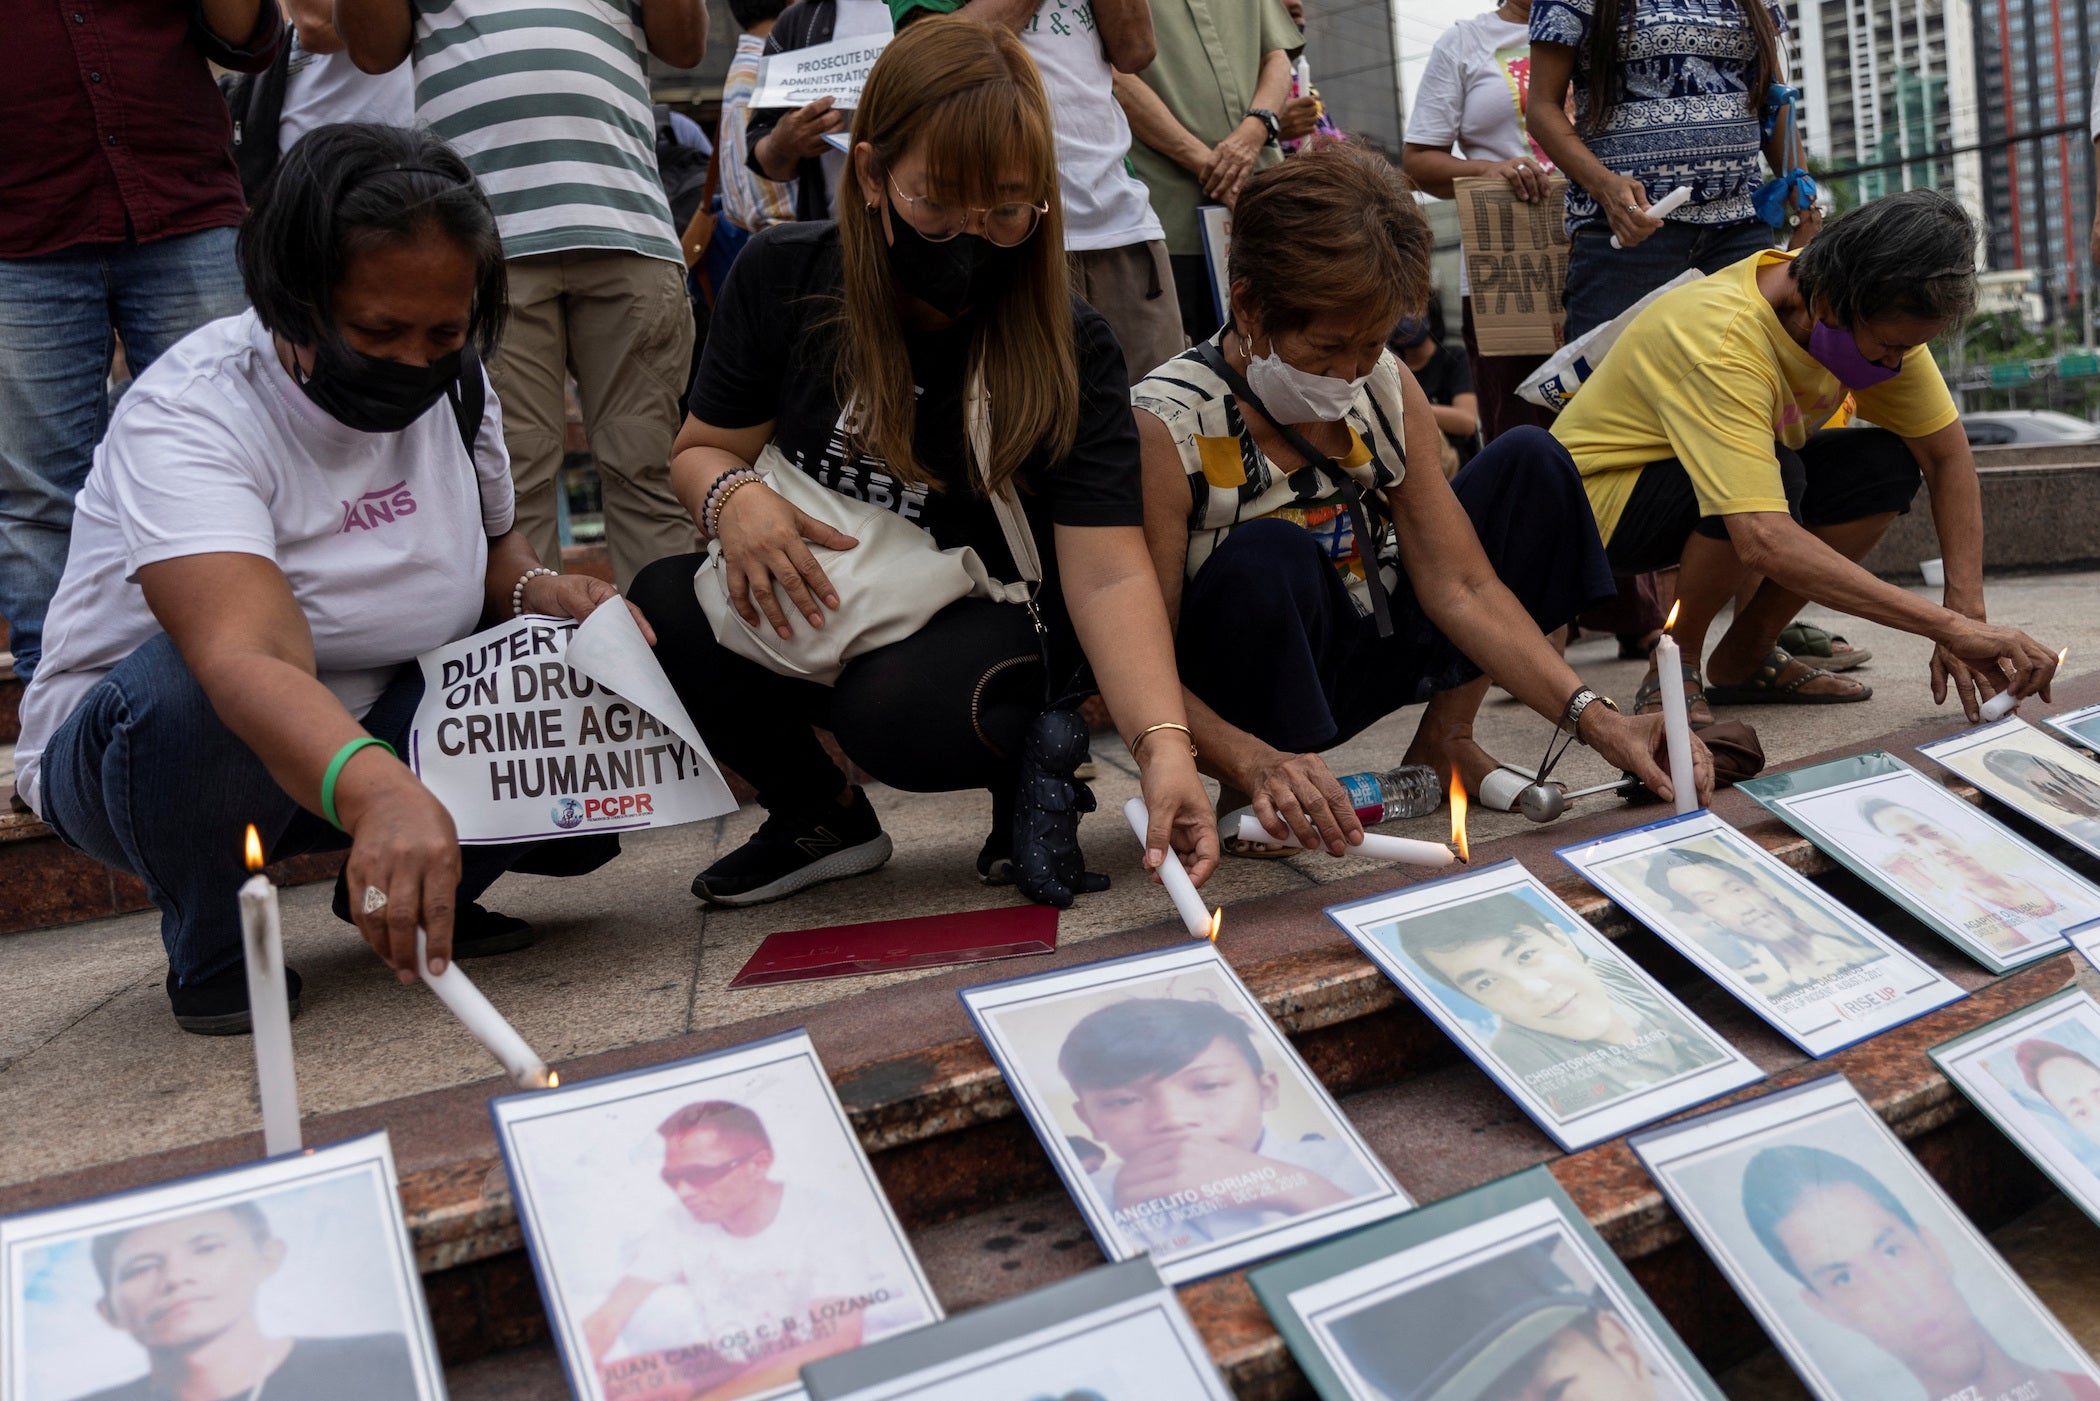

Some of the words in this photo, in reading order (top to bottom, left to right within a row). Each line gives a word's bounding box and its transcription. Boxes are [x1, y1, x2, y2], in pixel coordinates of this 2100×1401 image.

[797, 51, 861, 73] PROSECUTE
[446, 671, 498, 710] ON
[437, 708, 566, 757] CRIME
[489, 740, 700, 801] HUMANITY!
[584, 793, 654, 819] PCPR
[1843, 993, 1880, 1014] RISE
[1874, 986, 1897, 1002] UP
[1523, 1048, 1611, 1085] CHRISTOPHER
[1623, 1029, 1669, 1051] LAZARO
[1113, 1188, 1199, 1224] ANGELITO
[1200, 1166, 1277, 1199] SORIANO
[603, 1358, 658, 1385] JUAN
[665, 1330, 751, 1366] CARLOS
[809, 1287, 891, 1325] LOZANO
